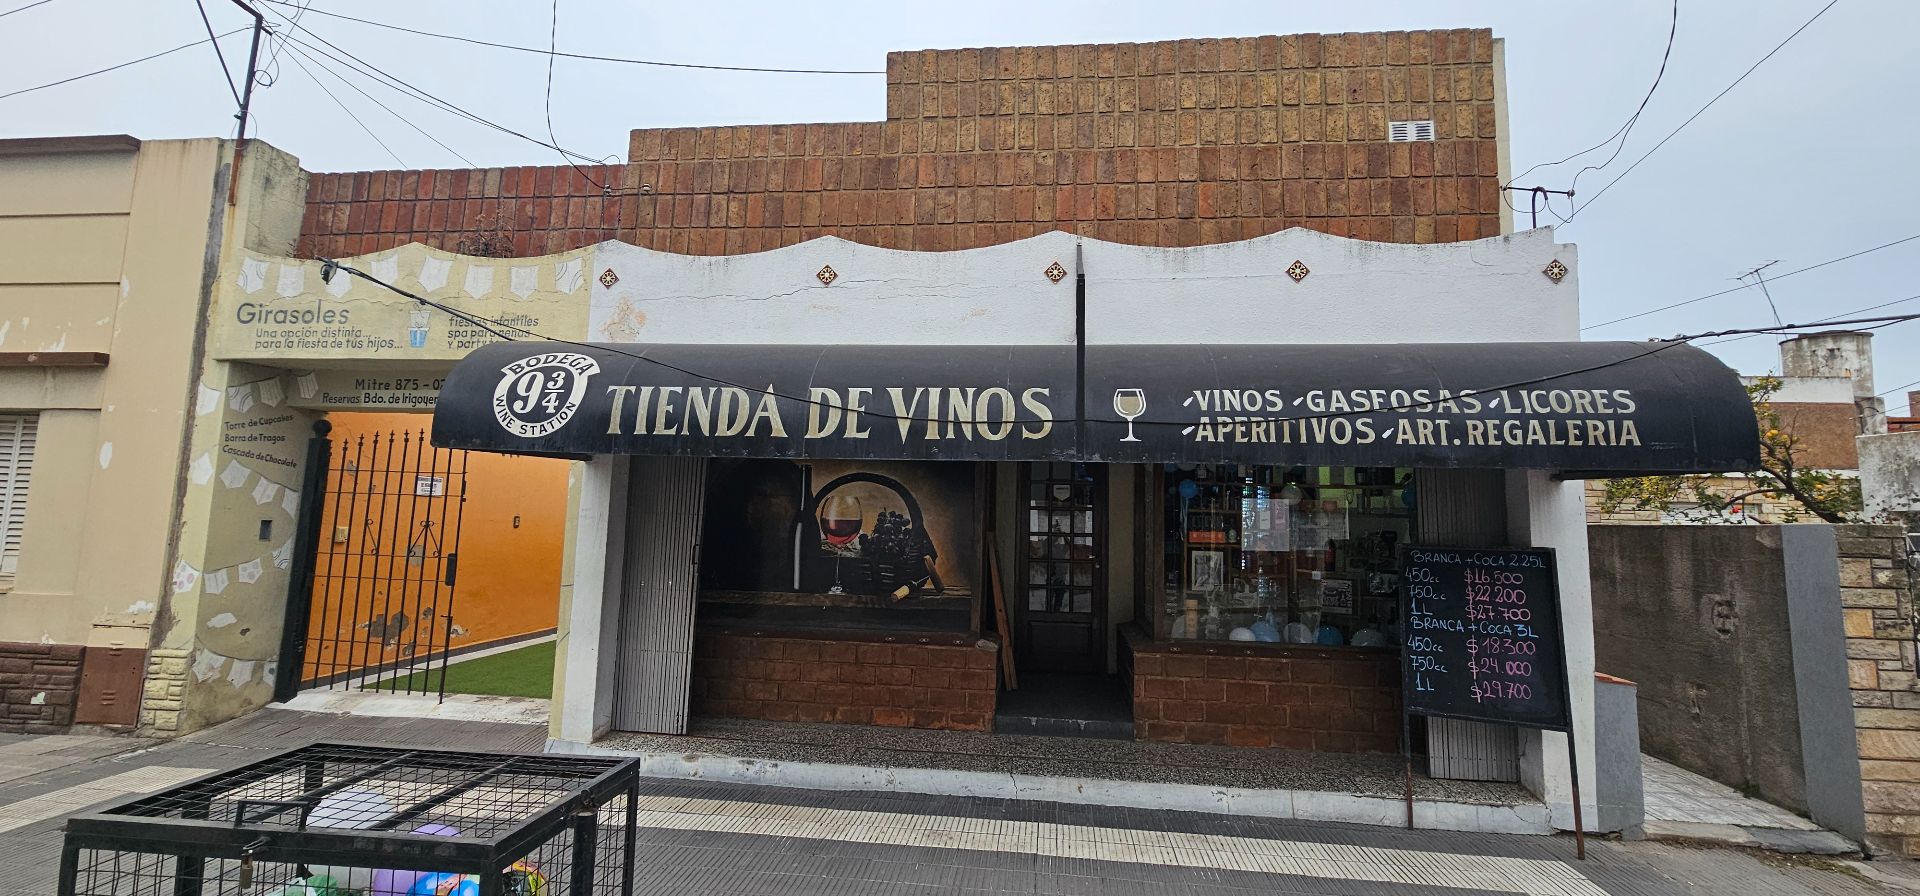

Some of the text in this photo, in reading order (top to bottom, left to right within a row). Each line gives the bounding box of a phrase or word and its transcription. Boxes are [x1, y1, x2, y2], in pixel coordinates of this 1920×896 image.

[236, 299, 350, 325] Girasoles
[491, 313, 539, 327] infantiles
[256, 328, 277, 338] Una
[280, 326, 318, 339] opción
[447, 329, 468, 340] spa
[255, 340, 282, 350] para
[283, 338, 294, 348] la
[297, 338, 328, 349] fiesta
[330, 338, 343, 348] de
[507, 354, 595, 376] BODEGA
[355, 378, 391, 390] Mitre
[395, 378, 419, 390] 875
[512, 371, 545, 414] 9
[322, 392, 360, 404] Reservas
[363, 392, 386, 404] Bdo.
[388, 392, 400, 404] de
[1193, 389, 1637, 414] VINOS GASEOSAS LICORES
[224, 414, 294, 431] Torre de Cupcakes
[495, 394, 577, 436] WINE STATION
[606, 384, 1053, 445] TIENDA DE VINOS
[224, 433, 286, 445] Barra de Tragos
[1194, 416, 1642, 446] APERITIVOS ART. REGALERIA
[222, 444, 297, 468] Cascada de Chocolate
[1411, 550, 1462, 565] BRANCA
[1509, 554, 1546, 569] 2.25L
[1405, 568, 1524, 585] 450cc $16.500
[1408, 585, 1447, 600] 750cc
[1465, 603, 1531, 621] $27.700
[1410, 616, 1465, 632] BRANCA
[1480, 621, 1512, 636] COCA
[1514, 623, 1539, 638] 3L
[1407, 635, 1444, 652] 450cc
[1410, 655, 1448, 673] 750cc
[1470, 681, 1532, 703] $29.700
